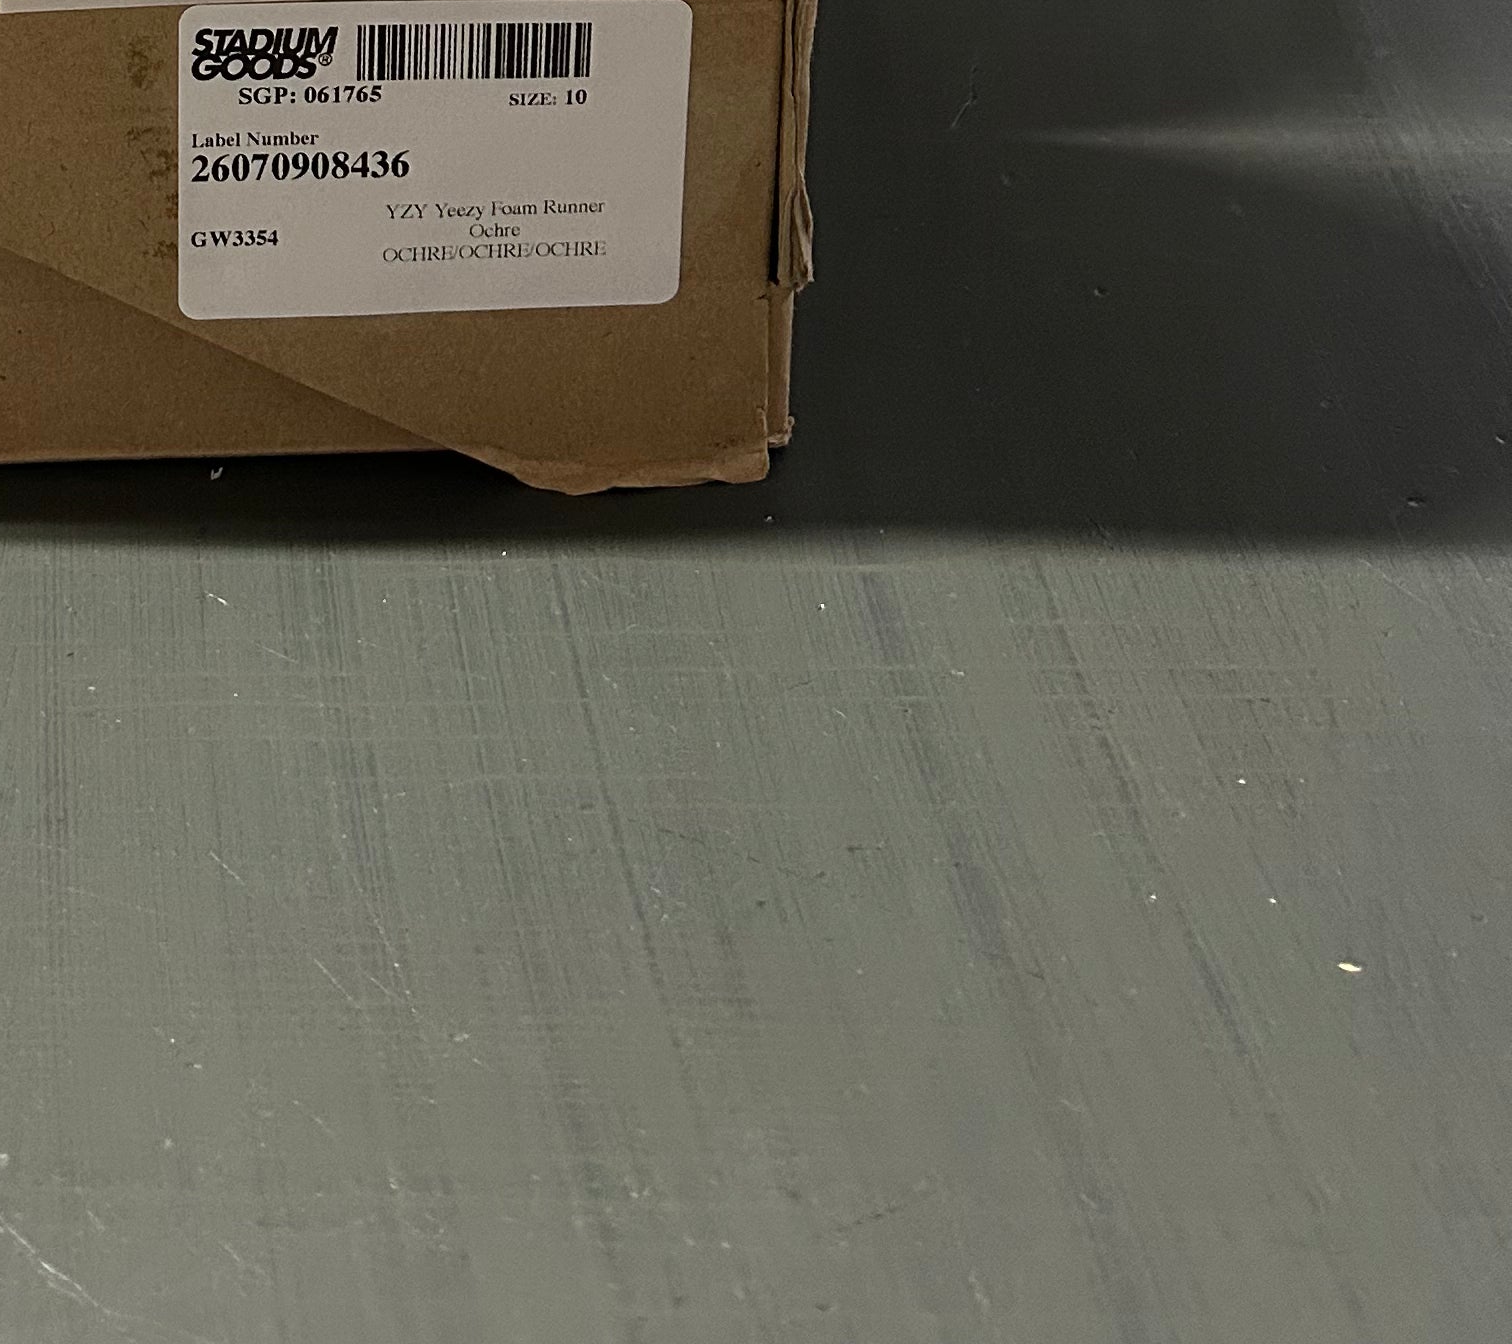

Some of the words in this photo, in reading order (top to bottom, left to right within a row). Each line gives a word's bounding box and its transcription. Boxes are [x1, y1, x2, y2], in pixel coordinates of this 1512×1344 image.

[191, 26, 339, 57] STADIUM
[238, 86, 296, 105] SGP:
[304, 85, 382, 104] 061765
[508, 91, 557, 107] SIZE:
[565, 88, 588, 105] 10
[191, 132, 241, 149] Label
[246, 131, 320, 148] Number
[191, 150, 410, 183] 26070908436
[386, 202, 428, 220] YZY
[434, 202, 486, 221] Yeezy
[491, 199, 538, 217] Foam
[543, 198, 607, 215] Runner
[190, 228, 279, 249] GW3354
[468, 222, 521, 239] Ochre
[382, 239, 607, 263] OCHRE/OCHRE/OCHRE
